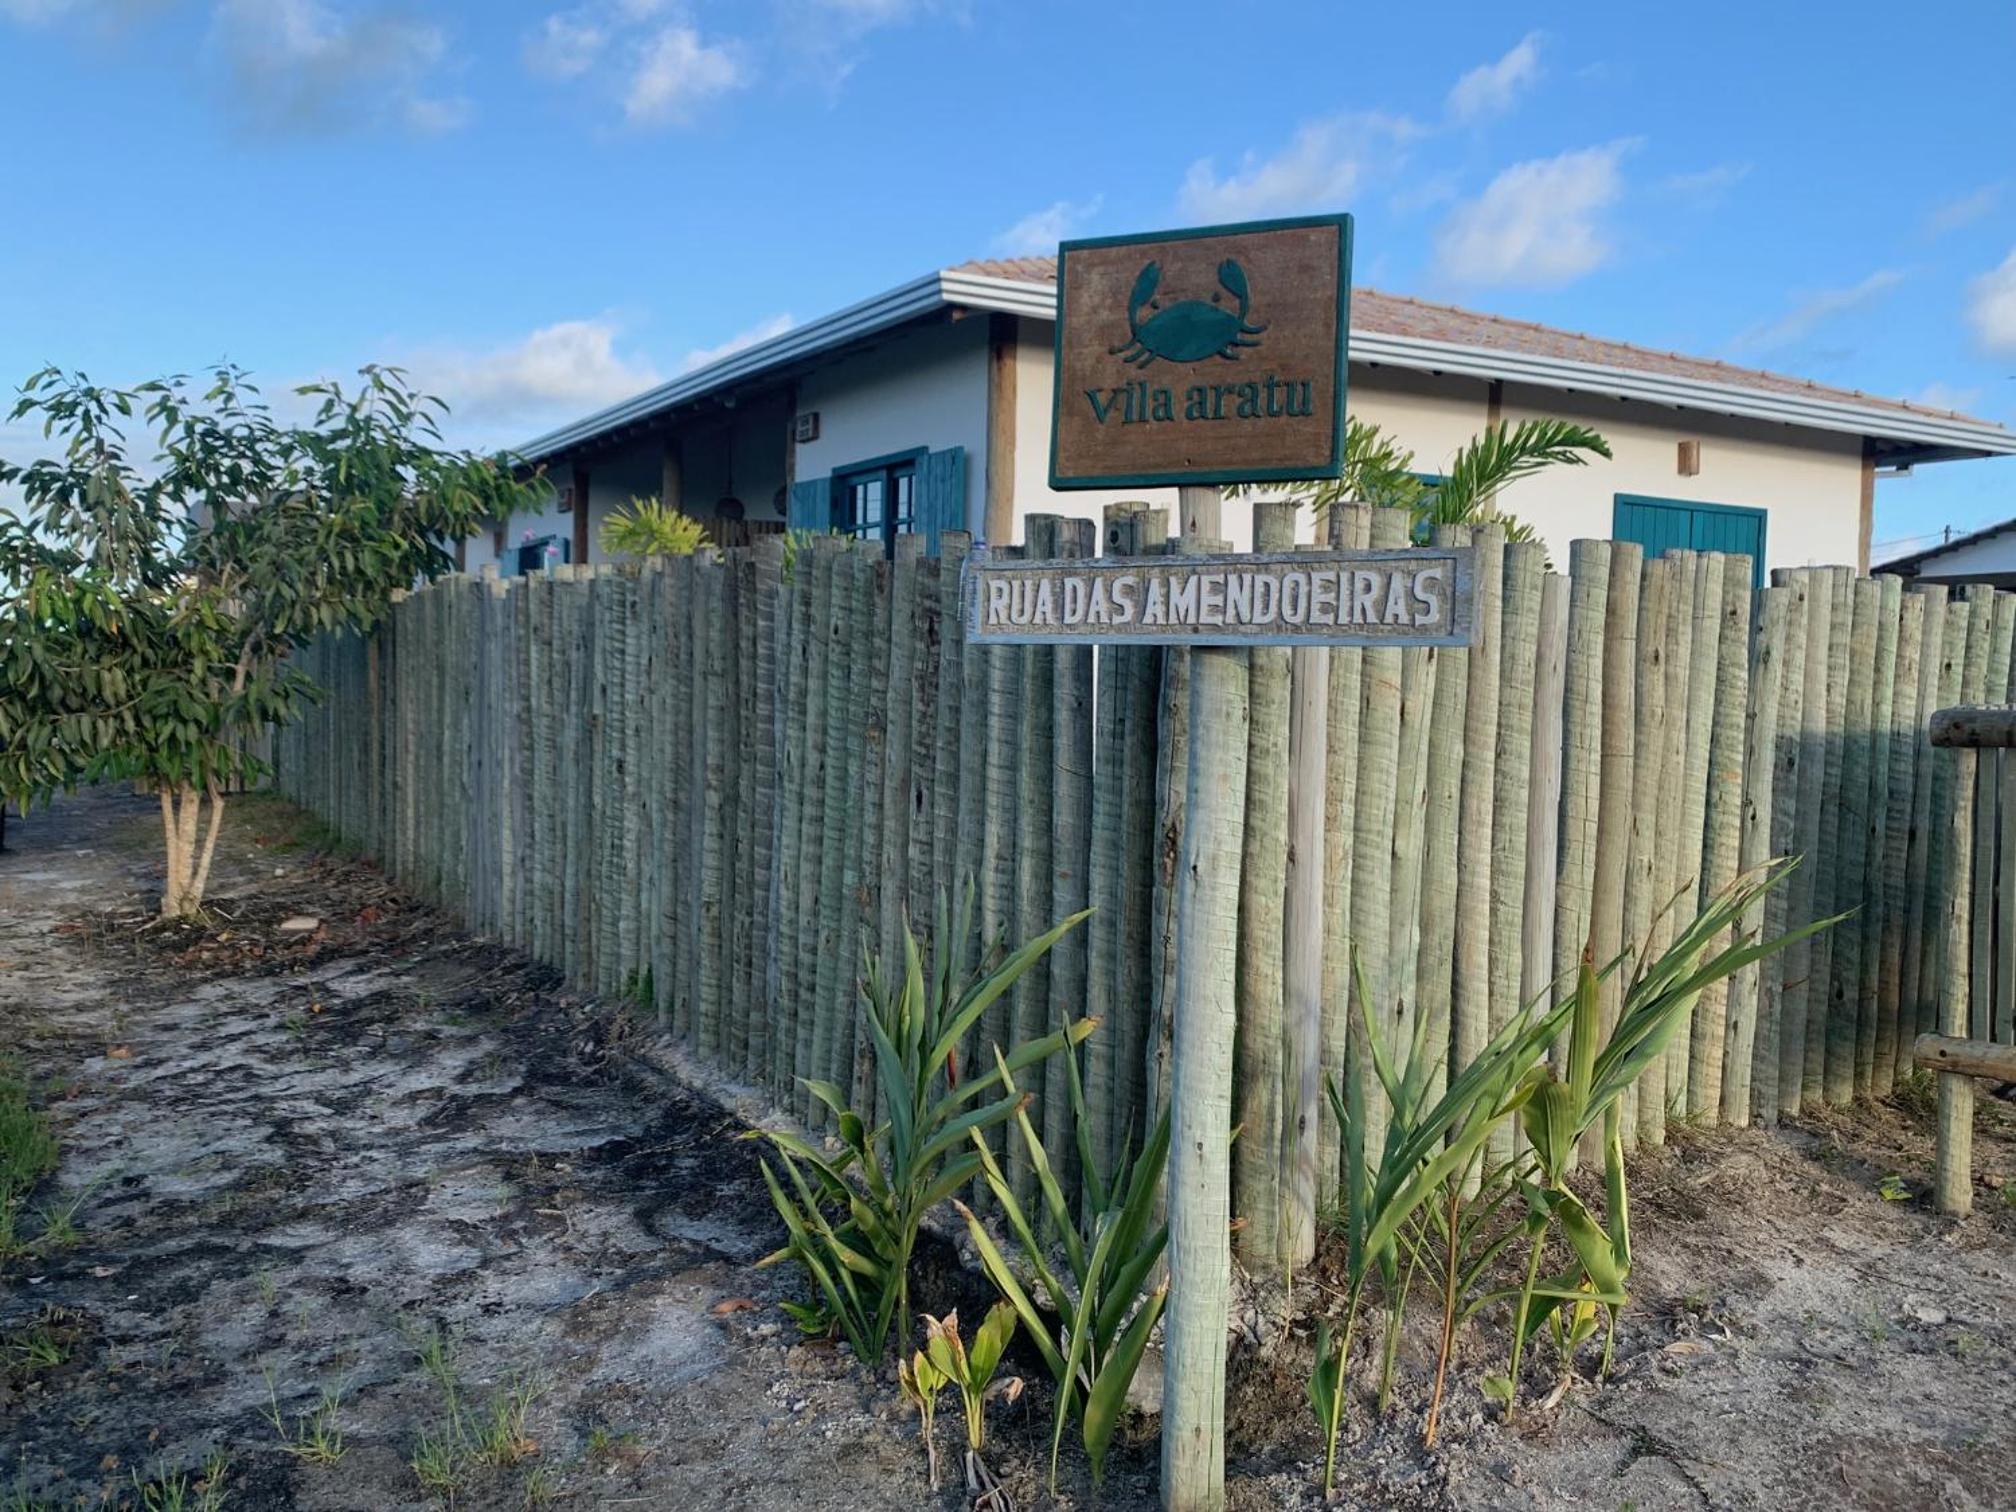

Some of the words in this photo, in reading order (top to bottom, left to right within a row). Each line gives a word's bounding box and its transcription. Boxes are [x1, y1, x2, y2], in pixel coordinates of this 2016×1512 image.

[1083, 377, 1174, 424] vila
[1185, 373, 1314, 421] aratu
[986, 578, 1056, 626] RUA
[1063, 575, 1140, 626] DAS
[1142, 567, 1443, 627] AMENDOEIRAS
